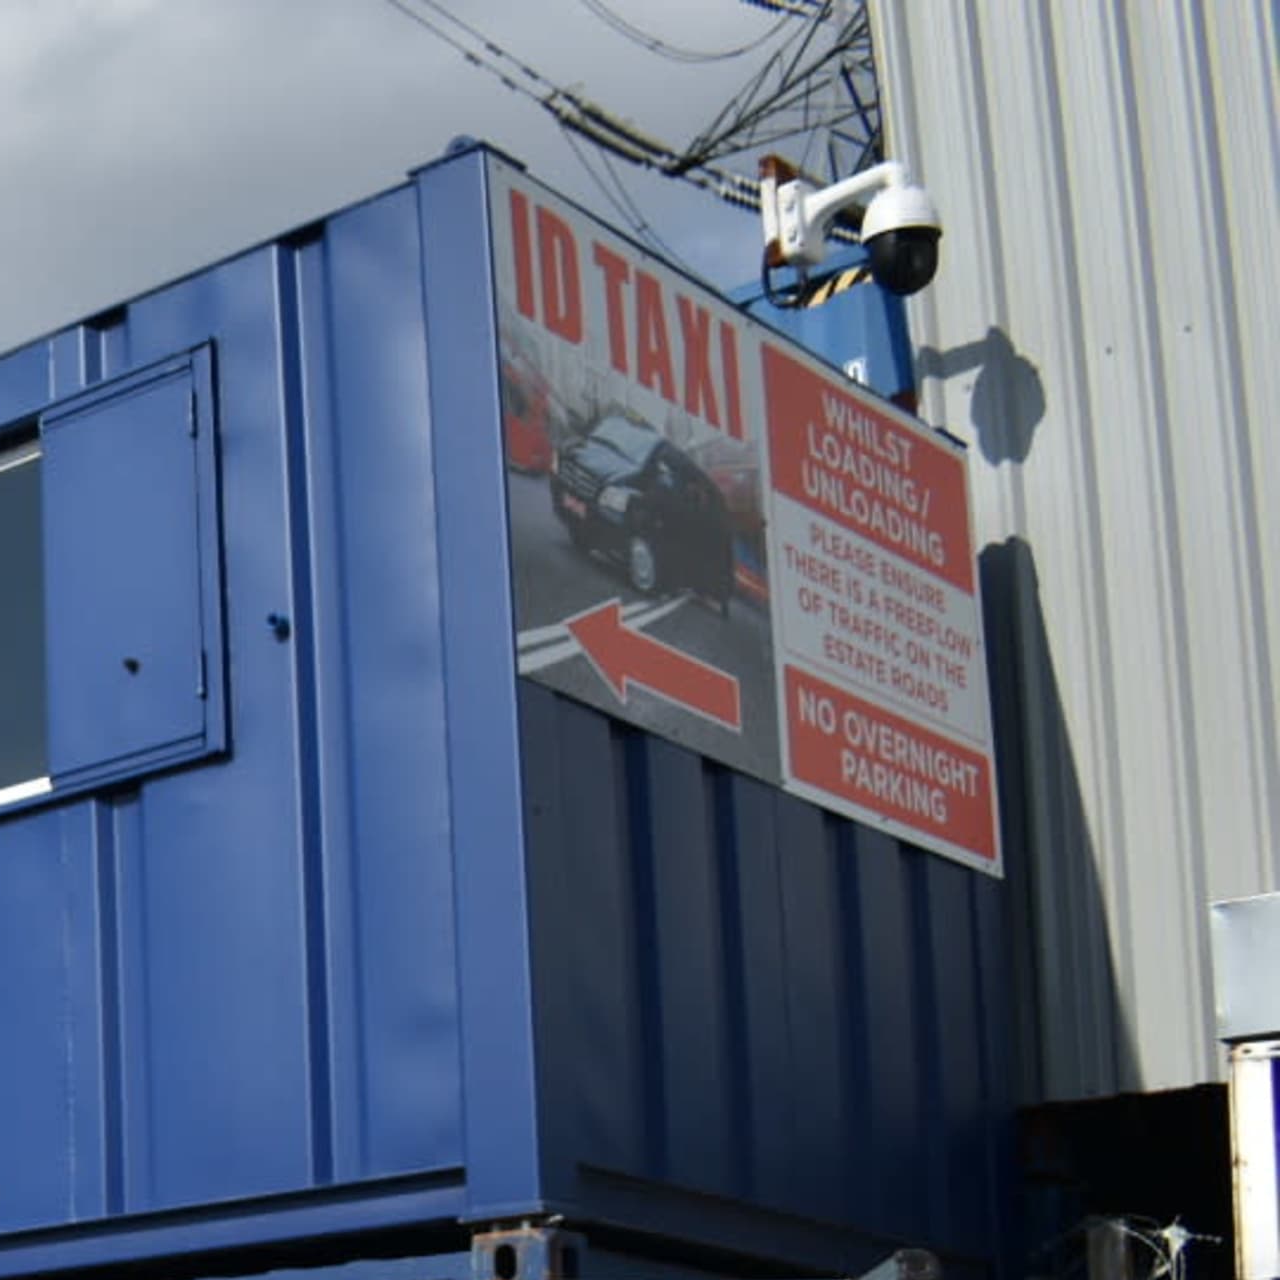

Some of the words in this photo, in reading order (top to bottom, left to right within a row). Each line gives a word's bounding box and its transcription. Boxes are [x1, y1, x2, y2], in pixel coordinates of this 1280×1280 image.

[511, 190, 583, 343] ID
[595, 245, 744, 438] TAXI
[822, 391, 913, 472] WHILST
[801, 459, 945, 567] UNLOADING
[784, 543, 842, 594] THERE
[847, 576, 863, 604] IS
[868, 589, 882, 610] A
[810, 521, 876, 577] PLEASE
[880, 559, 947, 614] ENSURE
[797, 586, 824, 614] OF
[827, 599, 901, 657] TRAFFIC
[906, 640, 931, 671] ON
[933, 653, 968, 689] THE
[822, 632, 887, 684] ESTATE
[890, 665, 949, 713] ROADS
[798, 684, 837, 736] NO
[843, 709, 980, 798] OVERNIGHT
[841, 748, 948, 825] PARKING
